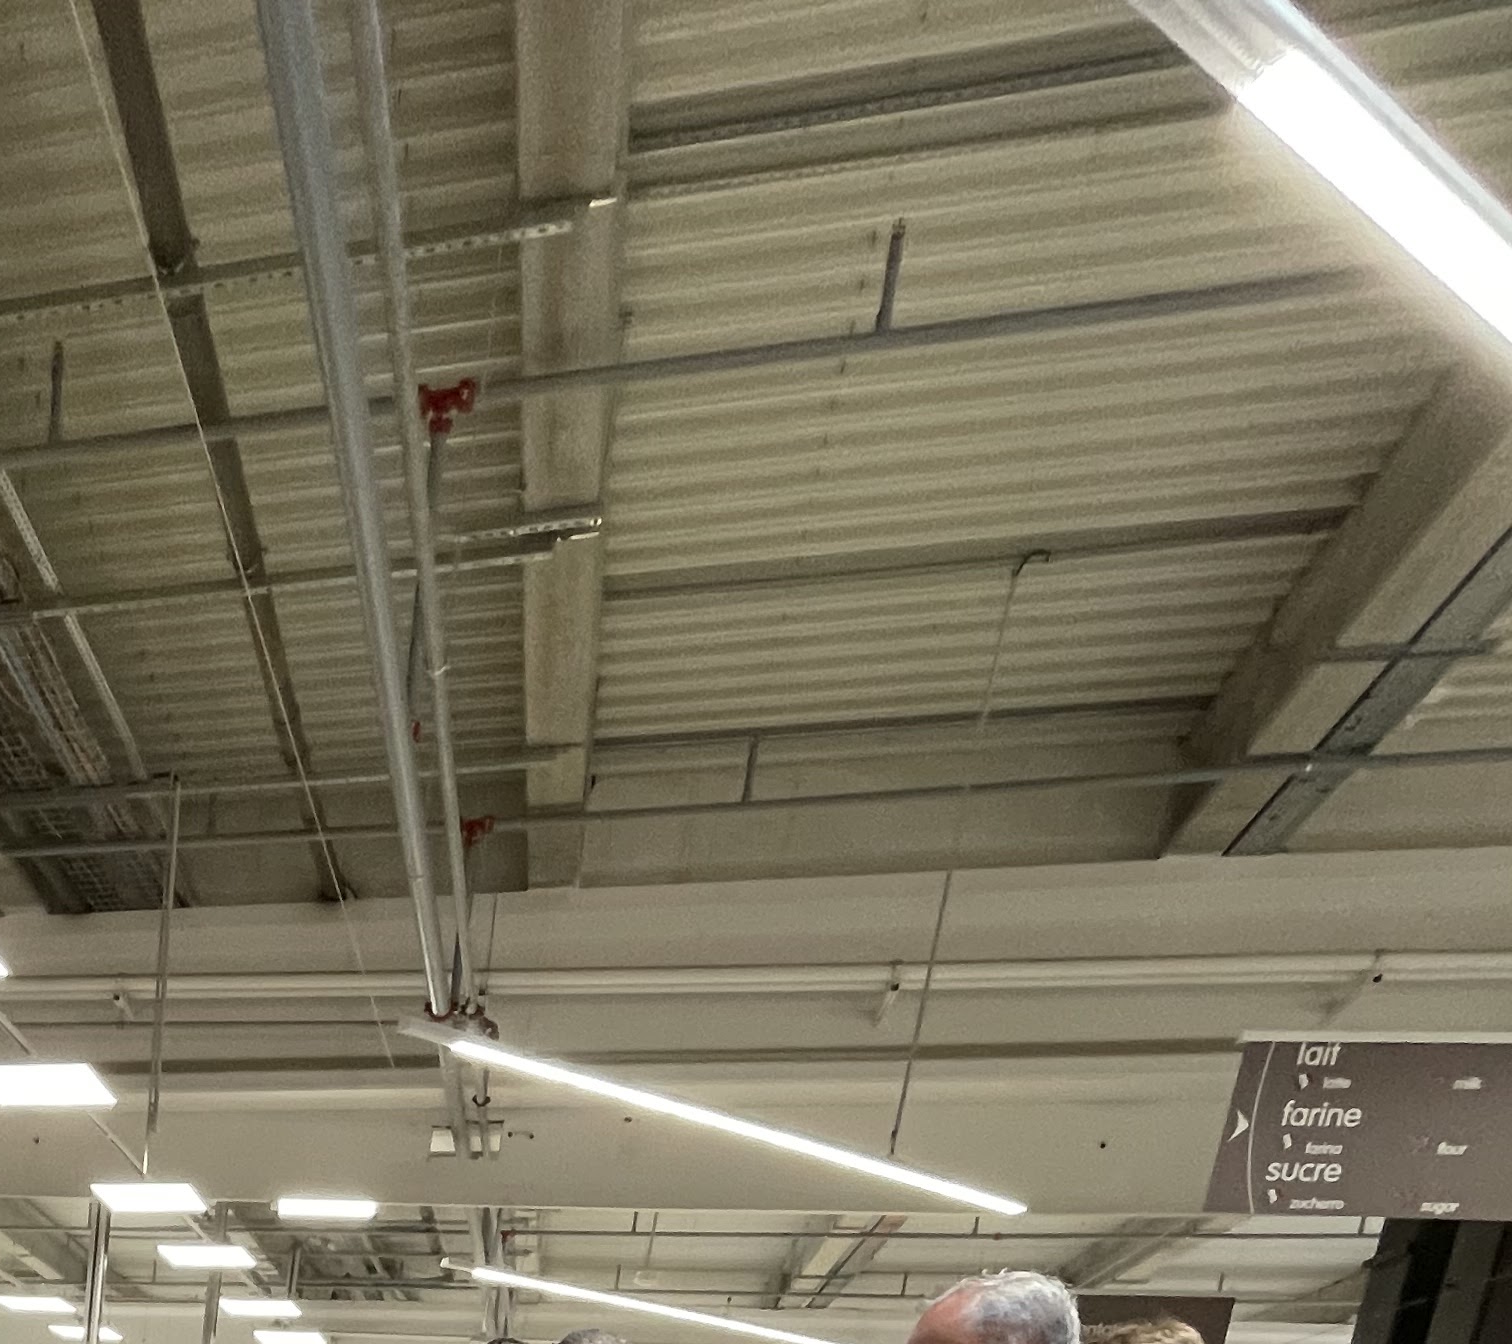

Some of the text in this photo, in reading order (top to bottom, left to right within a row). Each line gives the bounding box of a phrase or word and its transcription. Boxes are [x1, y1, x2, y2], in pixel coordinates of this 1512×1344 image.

[1296, 1042, 1341, 1066] lait
[1281, 1100, 1363, 1128] farine
[1265, 1162, 1342, 1182] sucre
